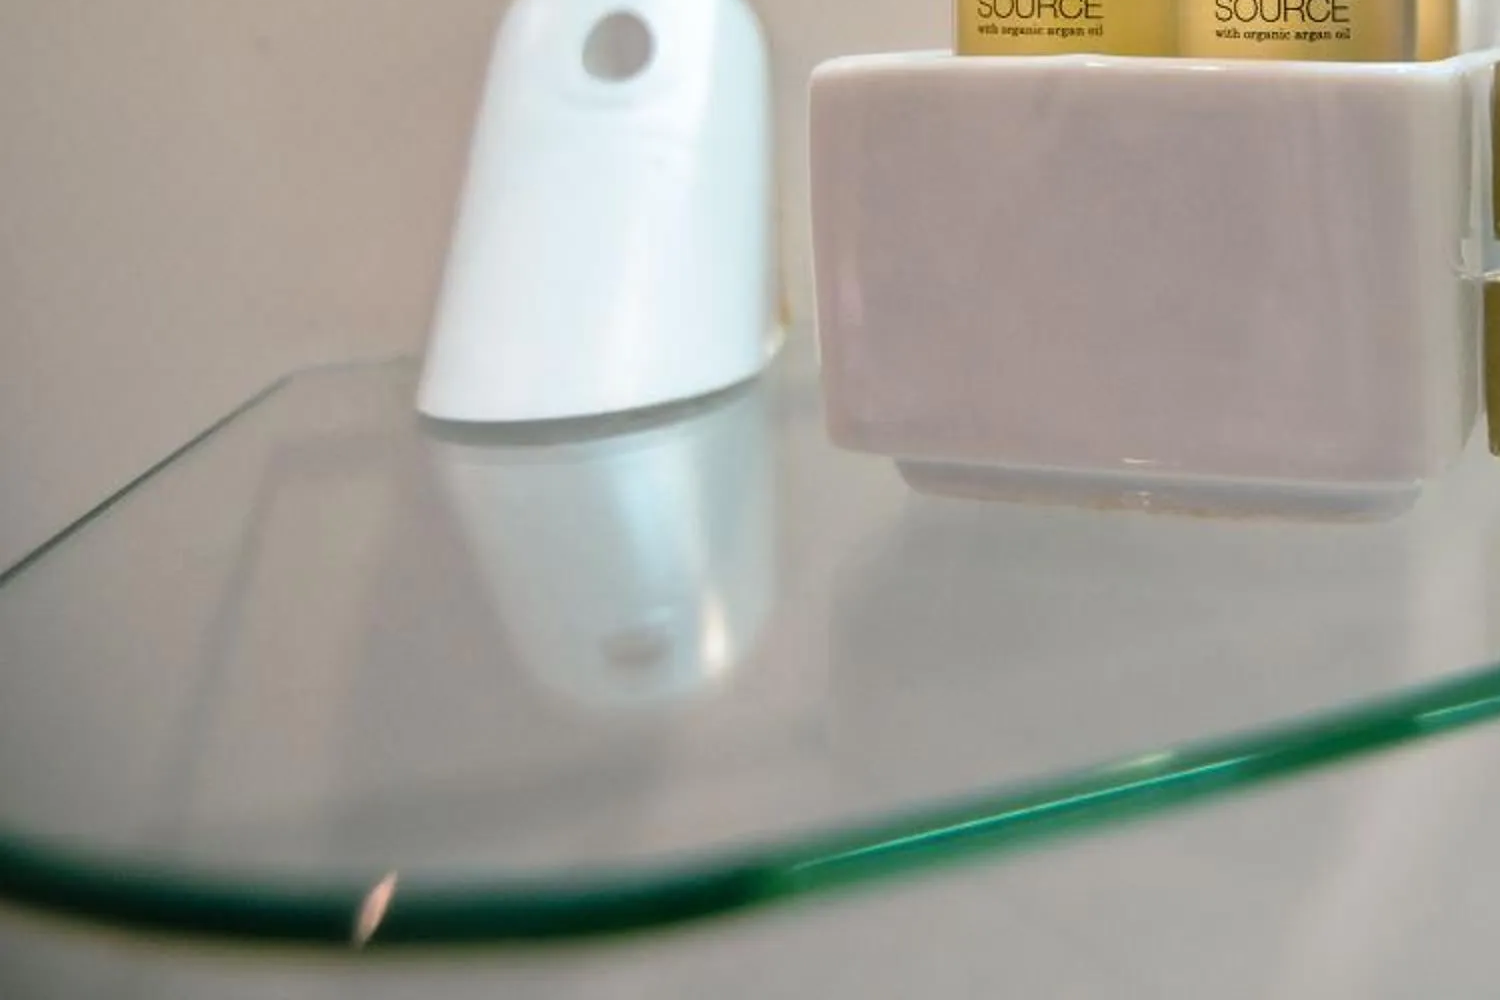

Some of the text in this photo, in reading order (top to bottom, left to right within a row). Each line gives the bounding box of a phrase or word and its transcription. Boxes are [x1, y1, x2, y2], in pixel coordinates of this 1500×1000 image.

[978, 22, 1104, 38] with organic argan oil
[1215, 27, 1351, 42] with organic argan oil
